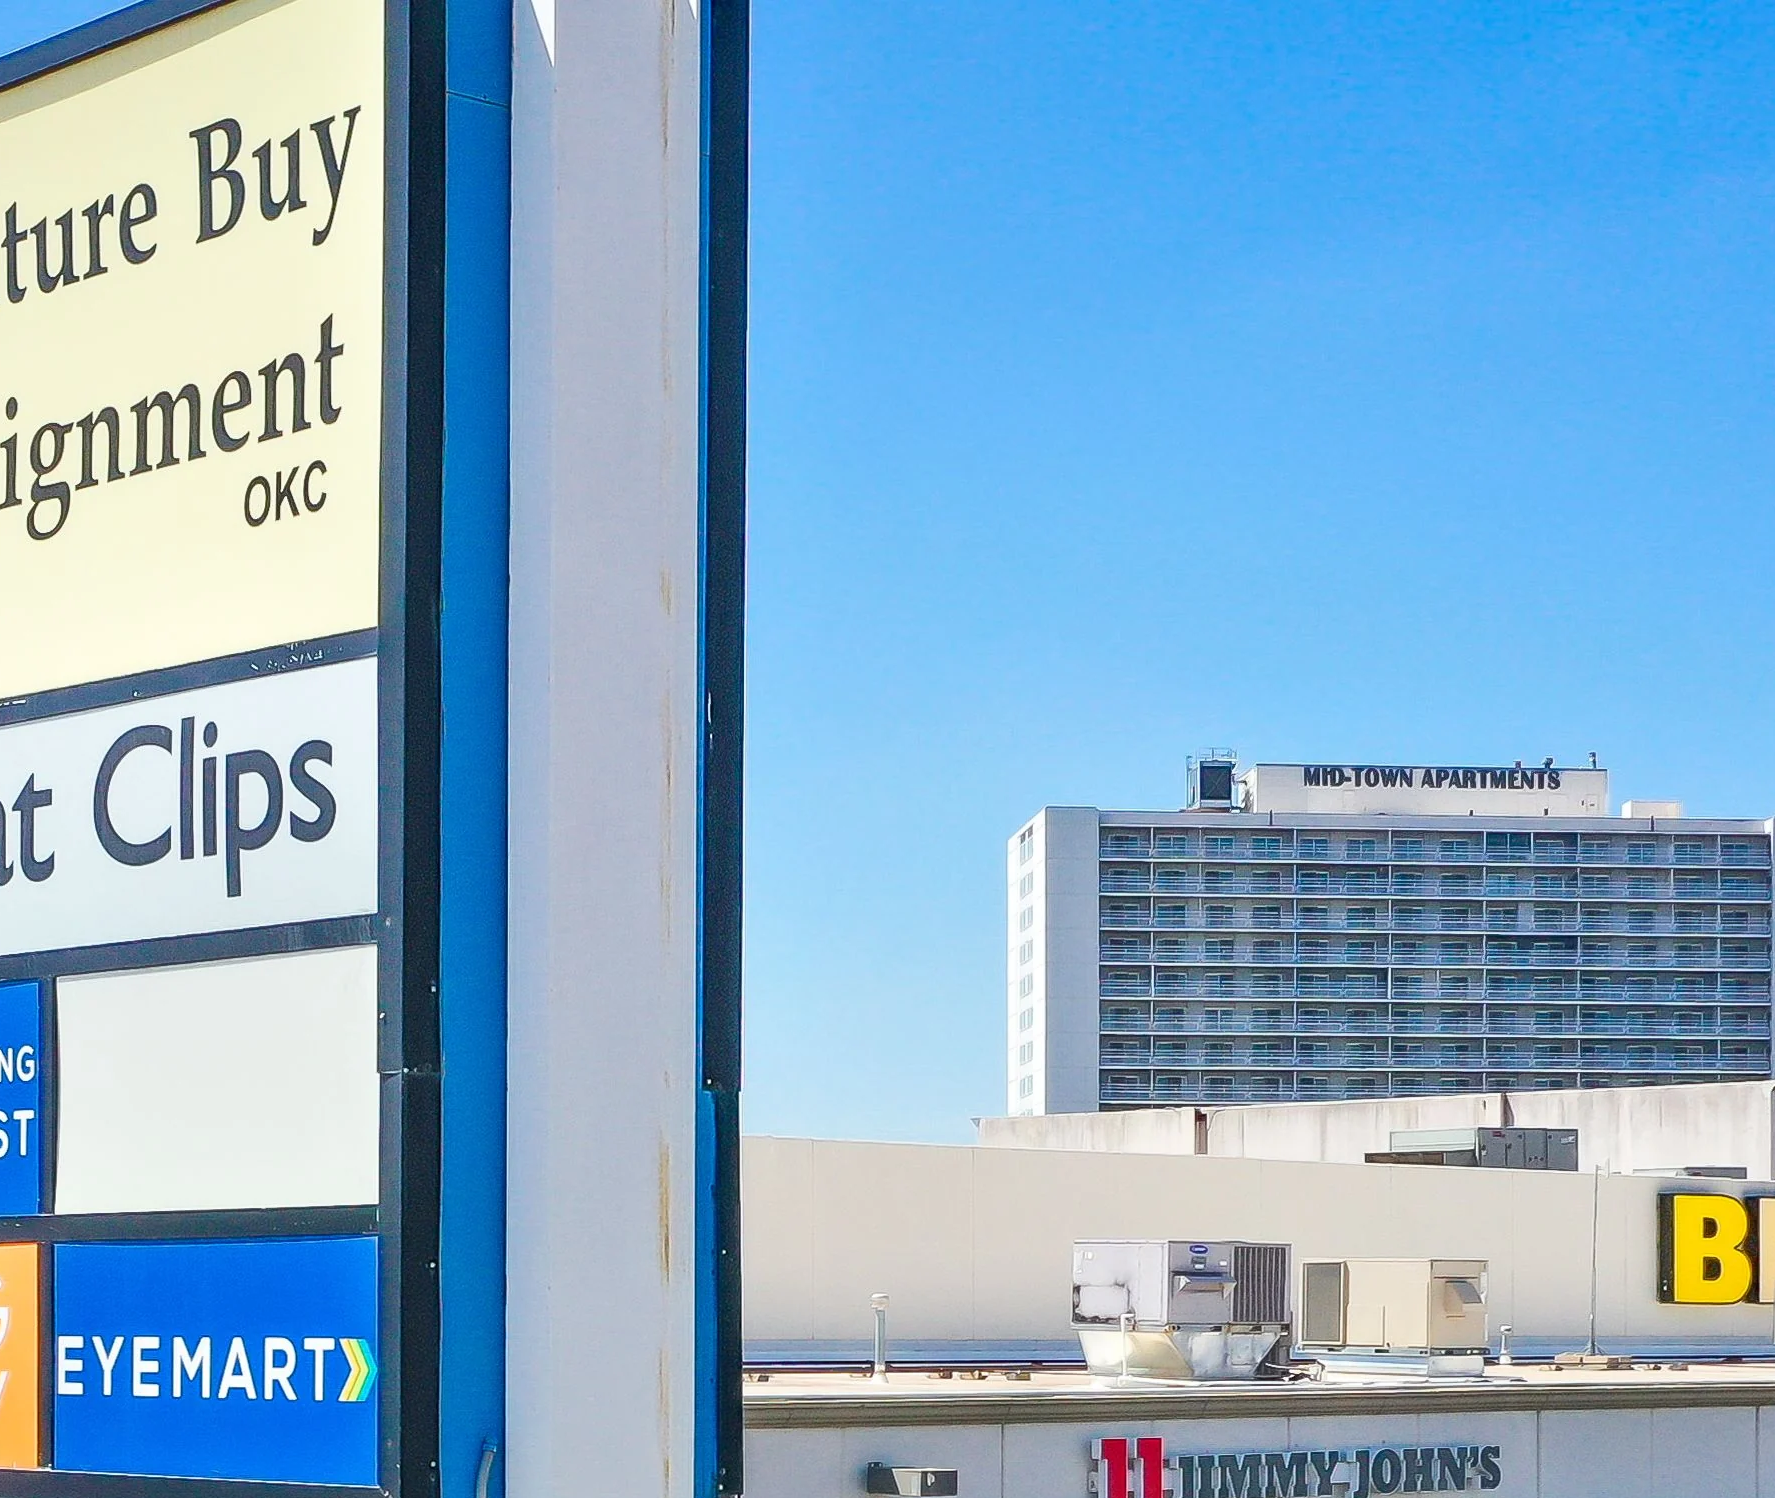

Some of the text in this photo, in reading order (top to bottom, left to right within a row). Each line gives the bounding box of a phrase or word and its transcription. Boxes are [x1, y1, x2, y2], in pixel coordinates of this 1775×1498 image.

[189, 105, 361, 246] Buy
[244, 460, 326, 527] OKC
[93, 716, 336, 898] Clips
[1304, 768, 1561, 789] MID-TOWN APARTMENTS
[57, 1336, 333, 1401] EYEMART
